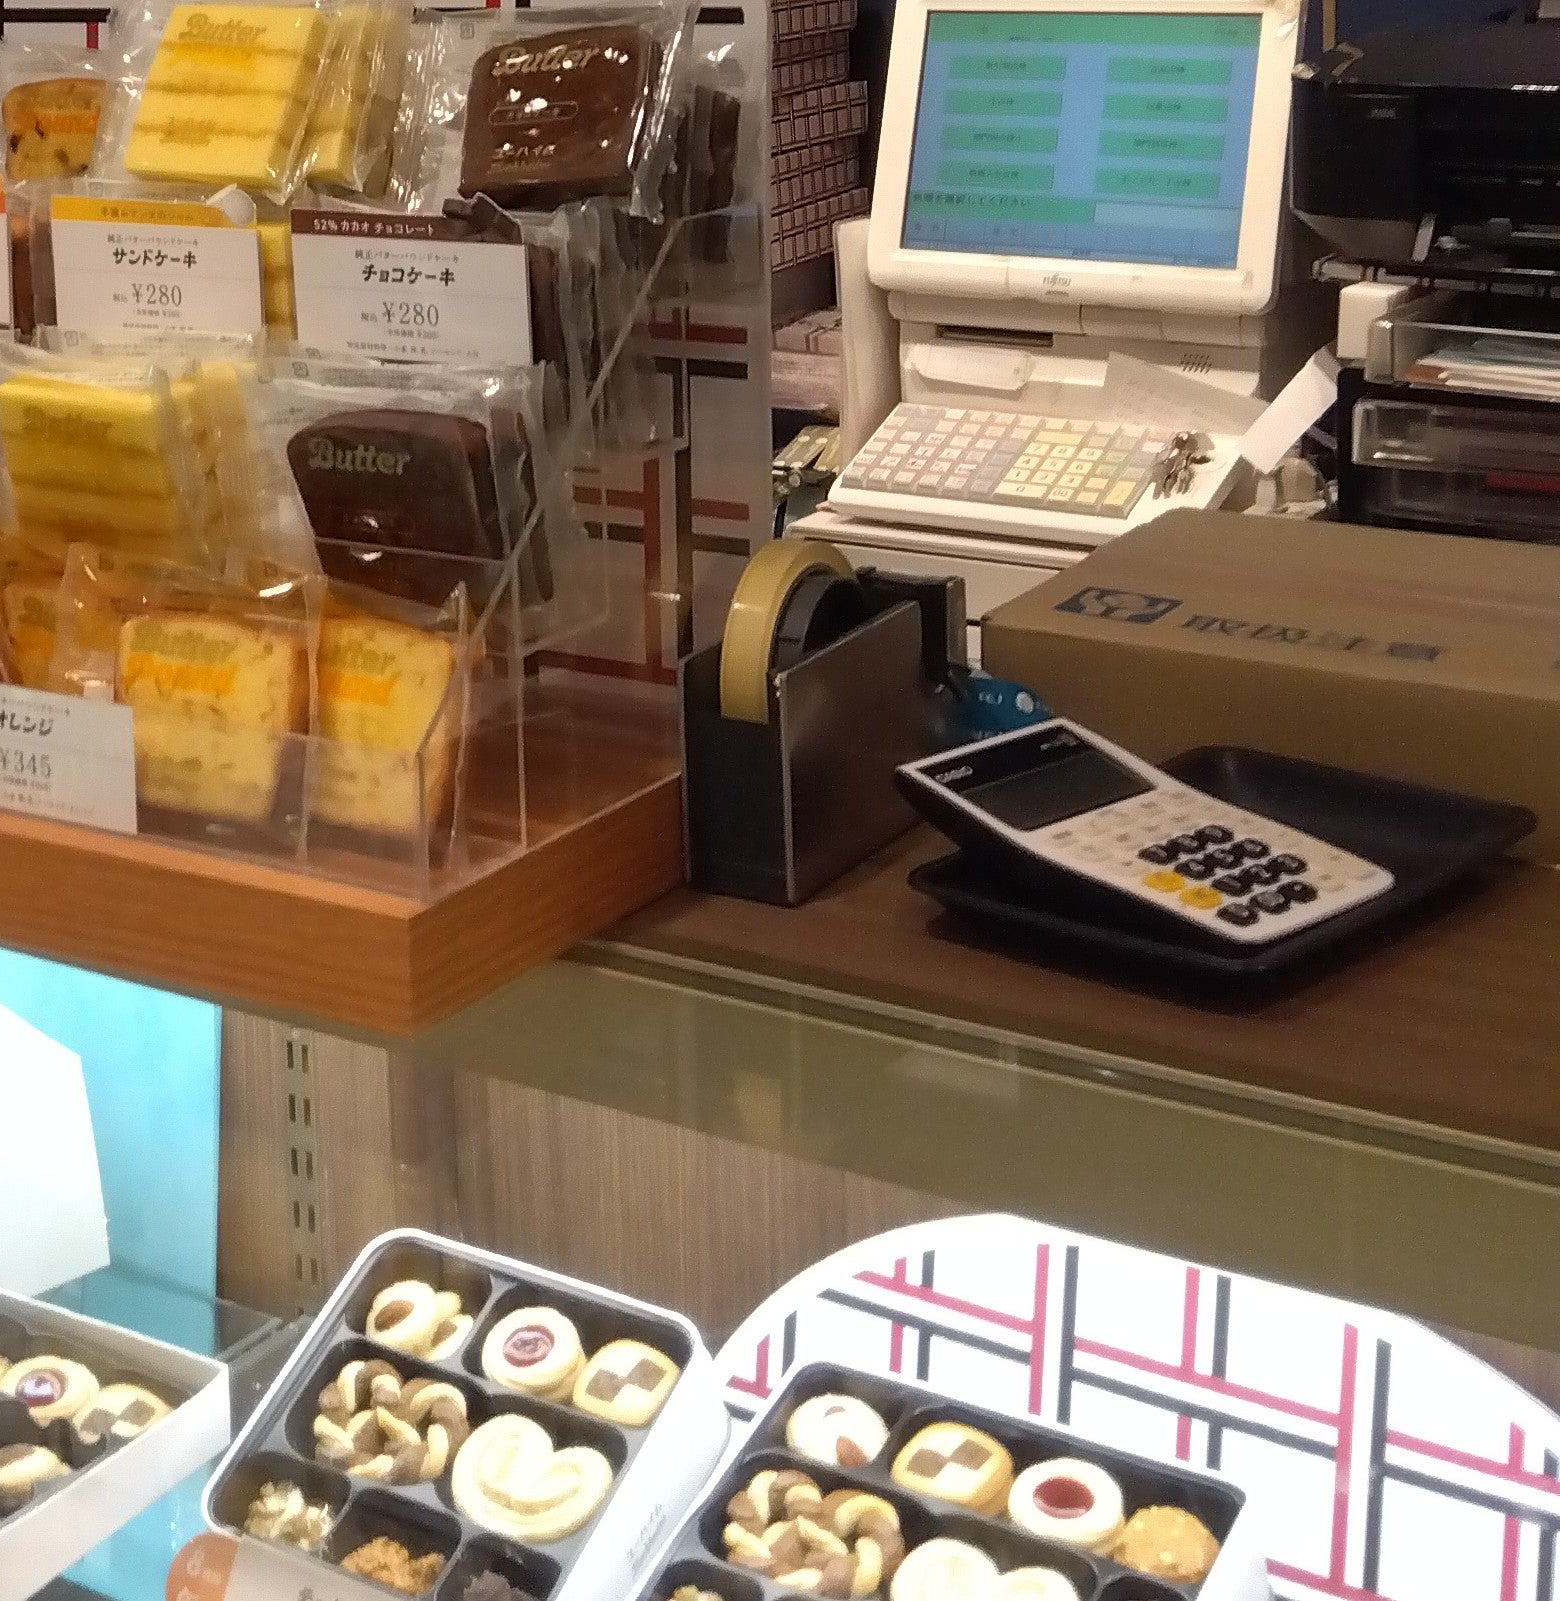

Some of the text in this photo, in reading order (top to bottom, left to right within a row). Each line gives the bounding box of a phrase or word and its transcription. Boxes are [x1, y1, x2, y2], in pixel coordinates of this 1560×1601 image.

[179, 12, 268, 43] Butter
[491, 42, 600, 78] Butter
[374, 222, 435, 237] チョコレート
[112, 247, 198, 269] サンドケーキ
[361, 263, 456, 287] チョコケーキ
[131, 283, 182, 308] ¥280
[382, 301, 440, 327] ¥280
[307, 434, 413, 477] Butter
